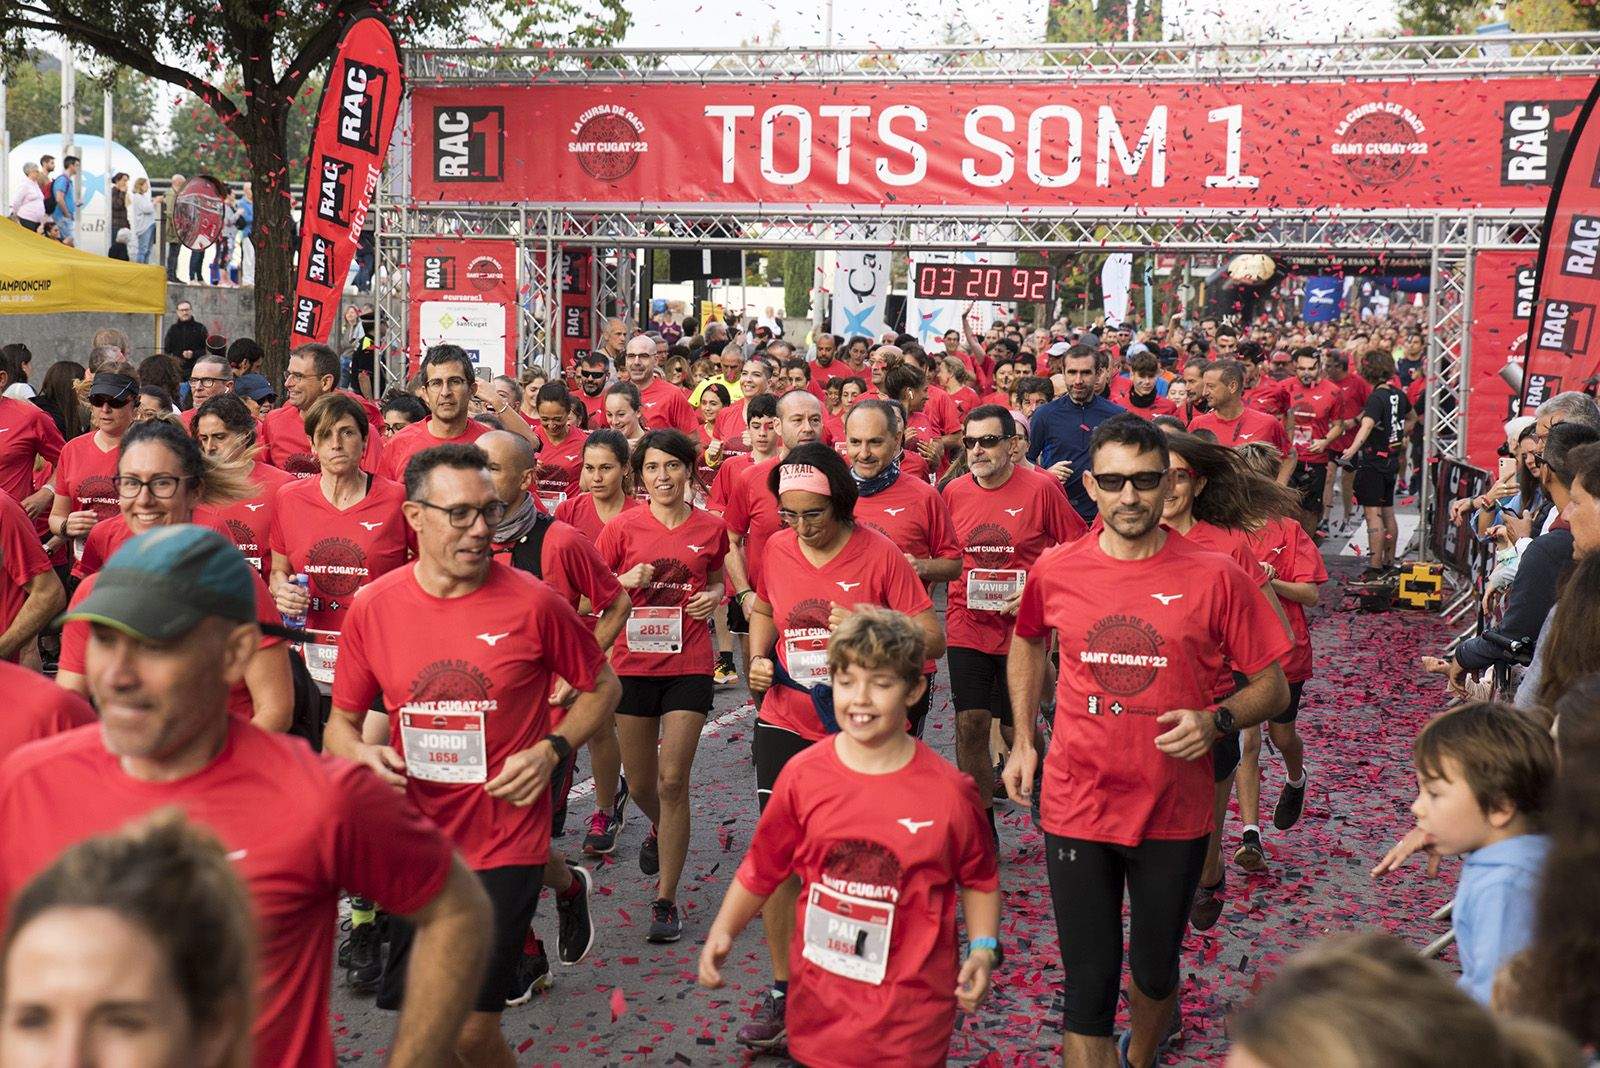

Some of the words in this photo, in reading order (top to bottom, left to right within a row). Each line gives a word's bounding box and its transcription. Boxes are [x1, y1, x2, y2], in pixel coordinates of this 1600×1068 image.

[342, 67, 367, 140] RAC
[570, 121, 583, 135] LA
[579, 104, 611, 123] CURSA
[612, 104, 626, 116] DE
[439, 111, 469, 177] RAC
[568, 142, 596, 152] SANT
[704, 104, 928, 186] TOTS
[961, 104, 1168, 188] SOM
[1205, 104, 1260, 188] 1
[1331, 143, 1363, 155] SANT
[1507, 105, 1550, 180] RAC
[426, 258, 441, 289] RAC
[295, 299, 313, 334] RAC
[1540, 302, 1569, 348] RAC
[304, 565, 327, 574] SANT
[978, 583, 1009, 592] XAVIER
[640, 624, 670, 635] 2815
[784, 629, 807, 638] SANT
[1080, 651, 1109, 663] SANT
[419, 733, 467, 749] JORDI
[428, 752, 458, 763] 1658
